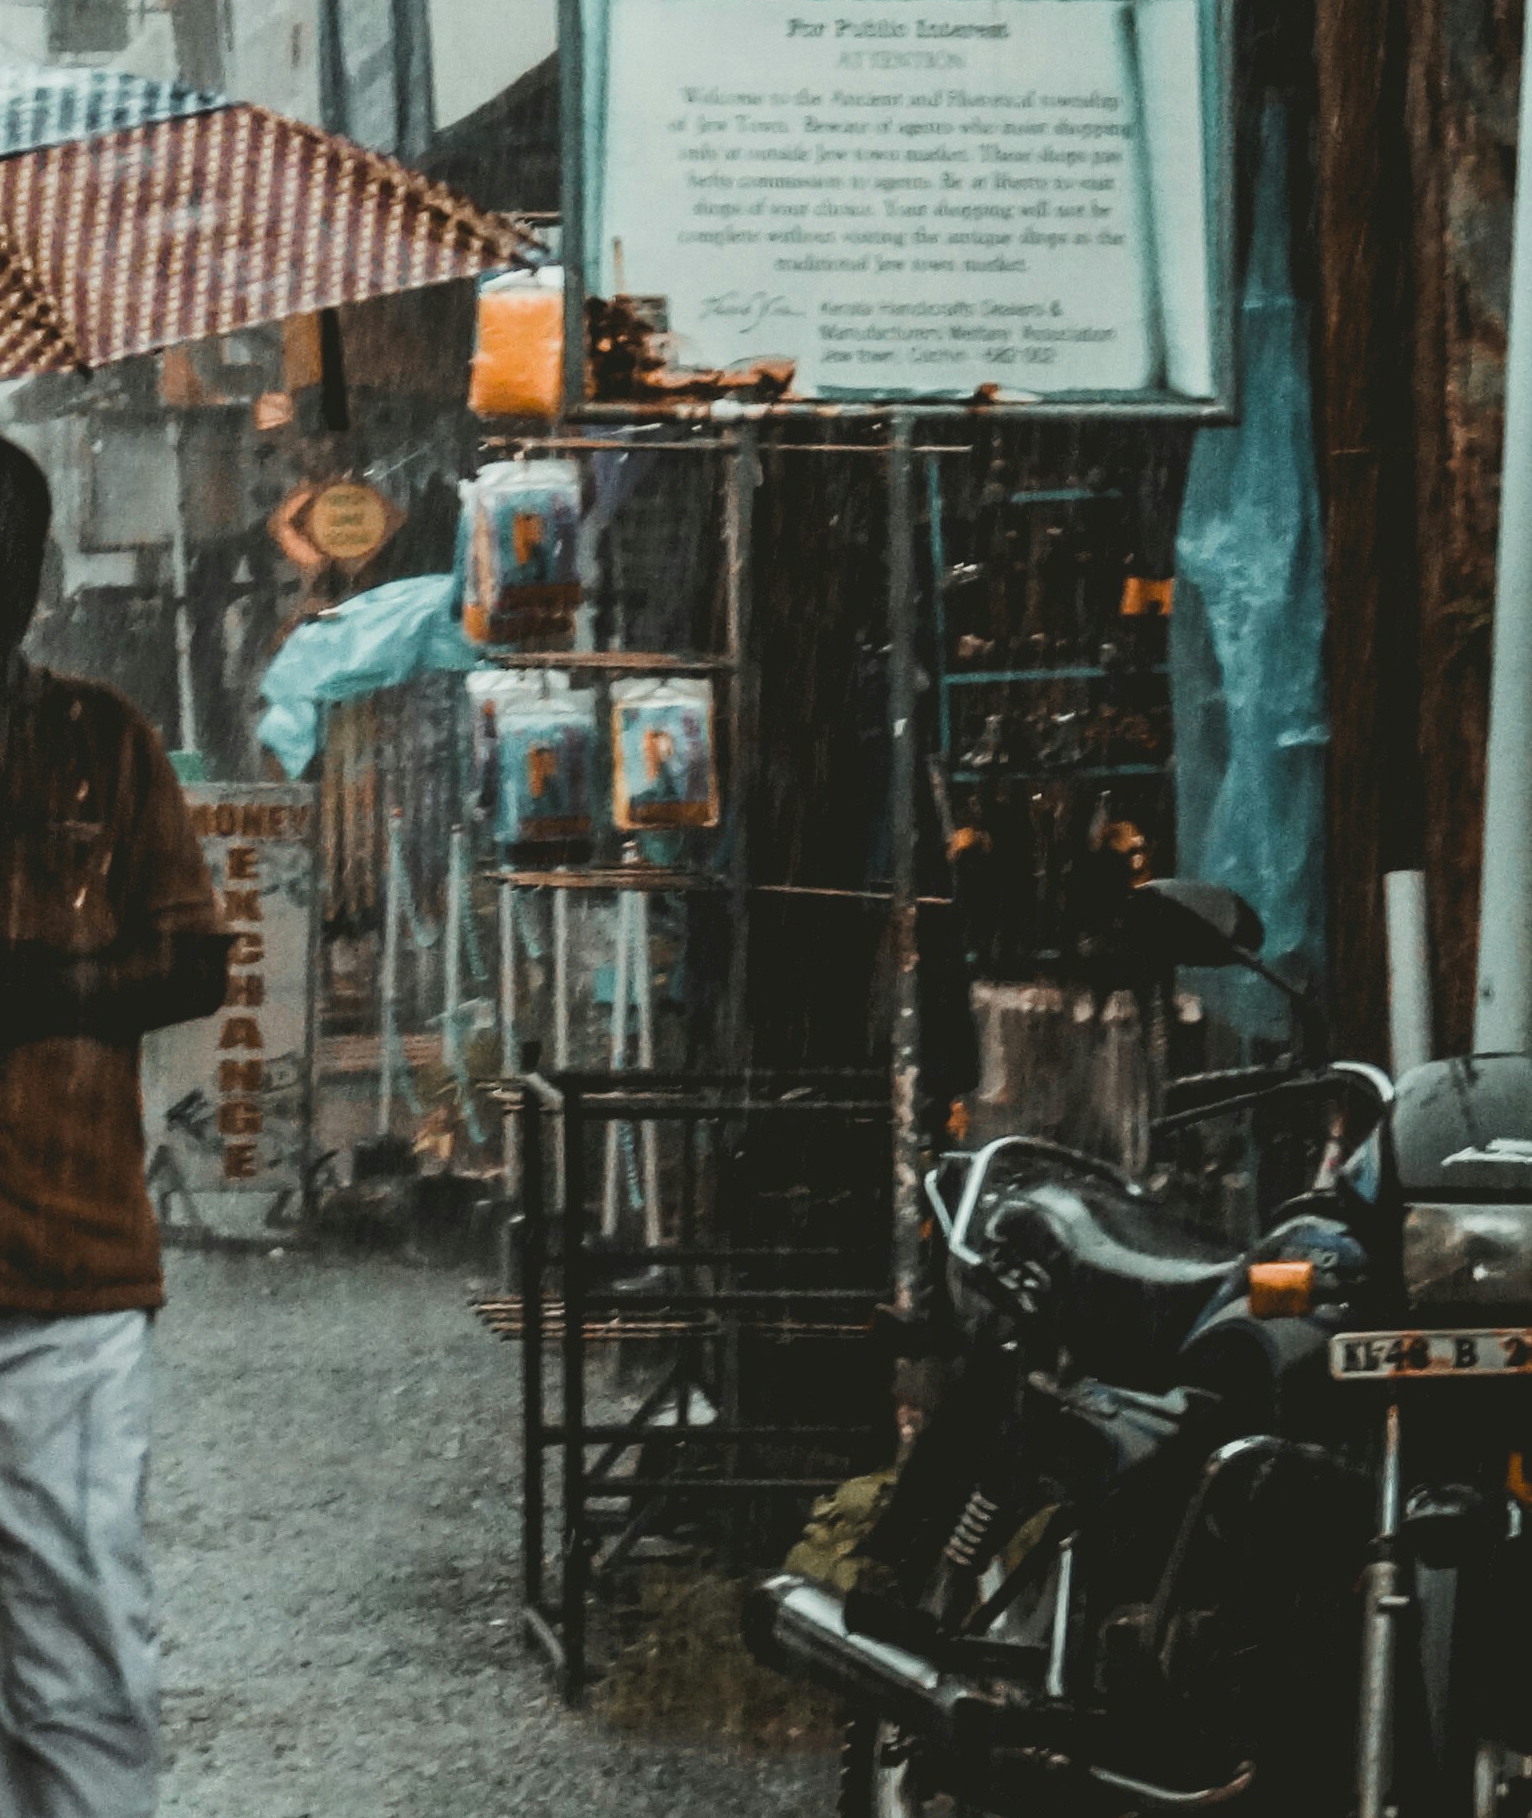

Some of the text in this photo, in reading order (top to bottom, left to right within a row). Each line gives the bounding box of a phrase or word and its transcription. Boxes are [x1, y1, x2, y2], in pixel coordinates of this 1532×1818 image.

[785, 17, 1009, 39] For Public Interest
[836, 49, 966, 70] ATTENTION
[678, 85, 762, 106] Welcome
[770, 90, 789, 106] to
[793, 87, 821, 107] the
[909, 89, 943, 108] and
[668, 113, 689, 132] of
[697, 114, 729, 134] Jew
[803, 114, 868, 134] Beware
[875, 114, 895, 134] of
[899, 122, 955, 137] agents
[959, 116, 996, 135] who
[814, 143, 849, 164] Jew
[853, 148, 901, 162] town
[1038, 144, 1087, 167] shops
[737, 175, 841, 190] commission
[851, 174, 868, 189] to
[691, 198, 742, 219] shops
[747, 196, 768, 216] of
[933, 199, 1015, 221] shopping
[1019, 199, 1050, 219] will
[1090, 199, 1114, 218] be
[676, 224, 760, 247] complete
[767, 224, 836, 244] without
[911, 225, 939, 244] the
[947, 231, 1012, 247] antique
[1020, 225, 1068, 249] shops
[1095, 226, 1126, 246] the
[773, 252, 868, 272] traditional
[873, 252, 905, 274] Jew
[910, 258, 956, 272] town
[1020, 325, 1116, 343] Association
[217, 847, 264, 1177] EXCHANGE
[1454, 1337, 1479, 1368] B
